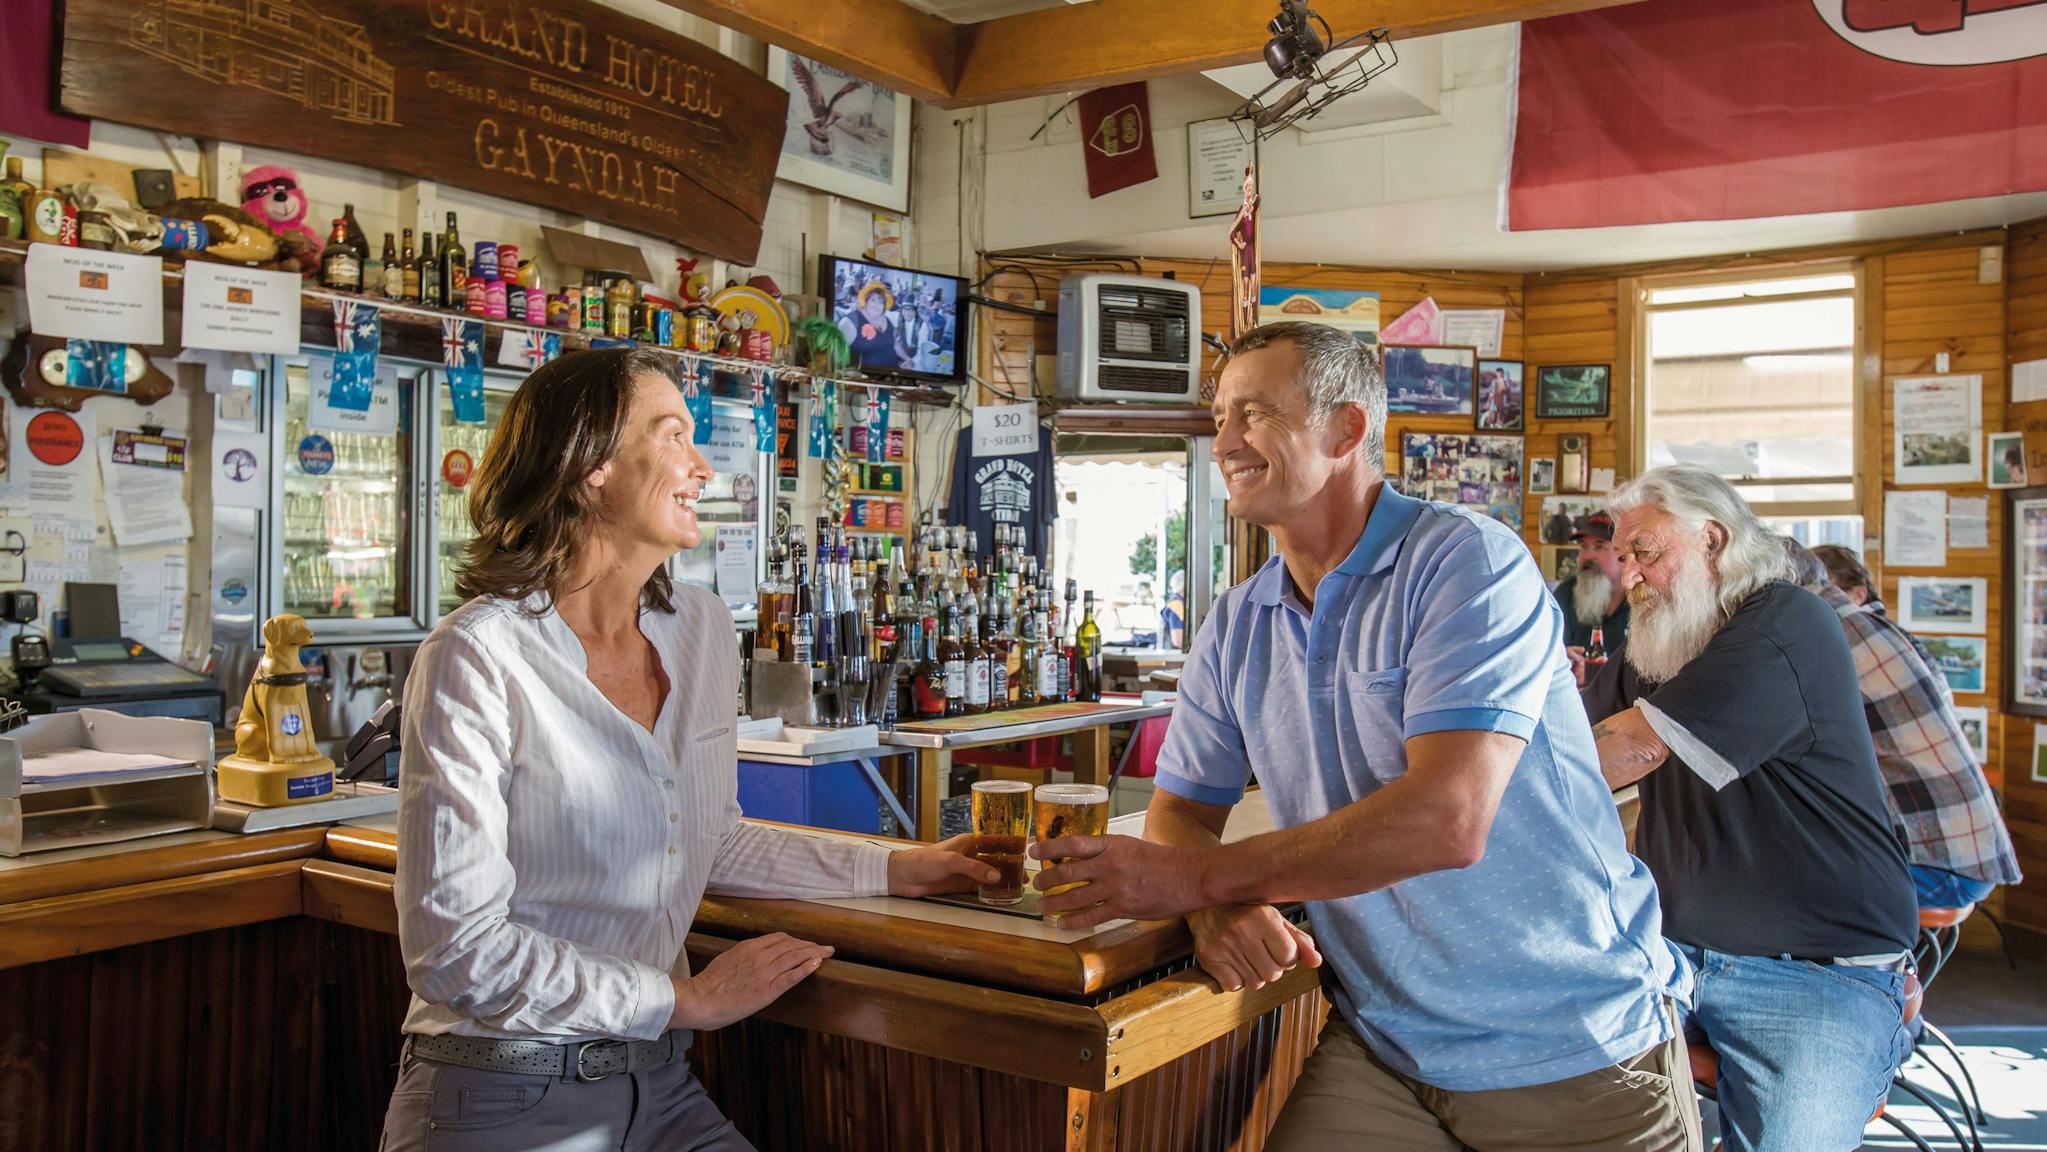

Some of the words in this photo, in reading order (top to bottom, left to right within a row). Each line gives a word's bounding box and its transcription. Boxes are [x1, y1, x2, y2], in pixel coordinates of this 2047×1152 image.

[427, 0, 588, 73] GRAND
[603, 34, 723, 119] HOTEL
[529, 77, 602, 110] Established
[603, 100, 631, 120] 1912
[486, 87, 518, 113] Pub
[522, 99, 536, 118] in
[540, 105, 639, 148] Queensland's
[474, 118, 679, 214] GAYNDAH
[339, 412, 366, 421] inside
[994, 412, 1021, 429] $20
[981, 433, 1033, 448] T-SHIRTS
[975, 458, 1005, 484] GRAND
[1006, 458, 1035, 485] HOTEL
